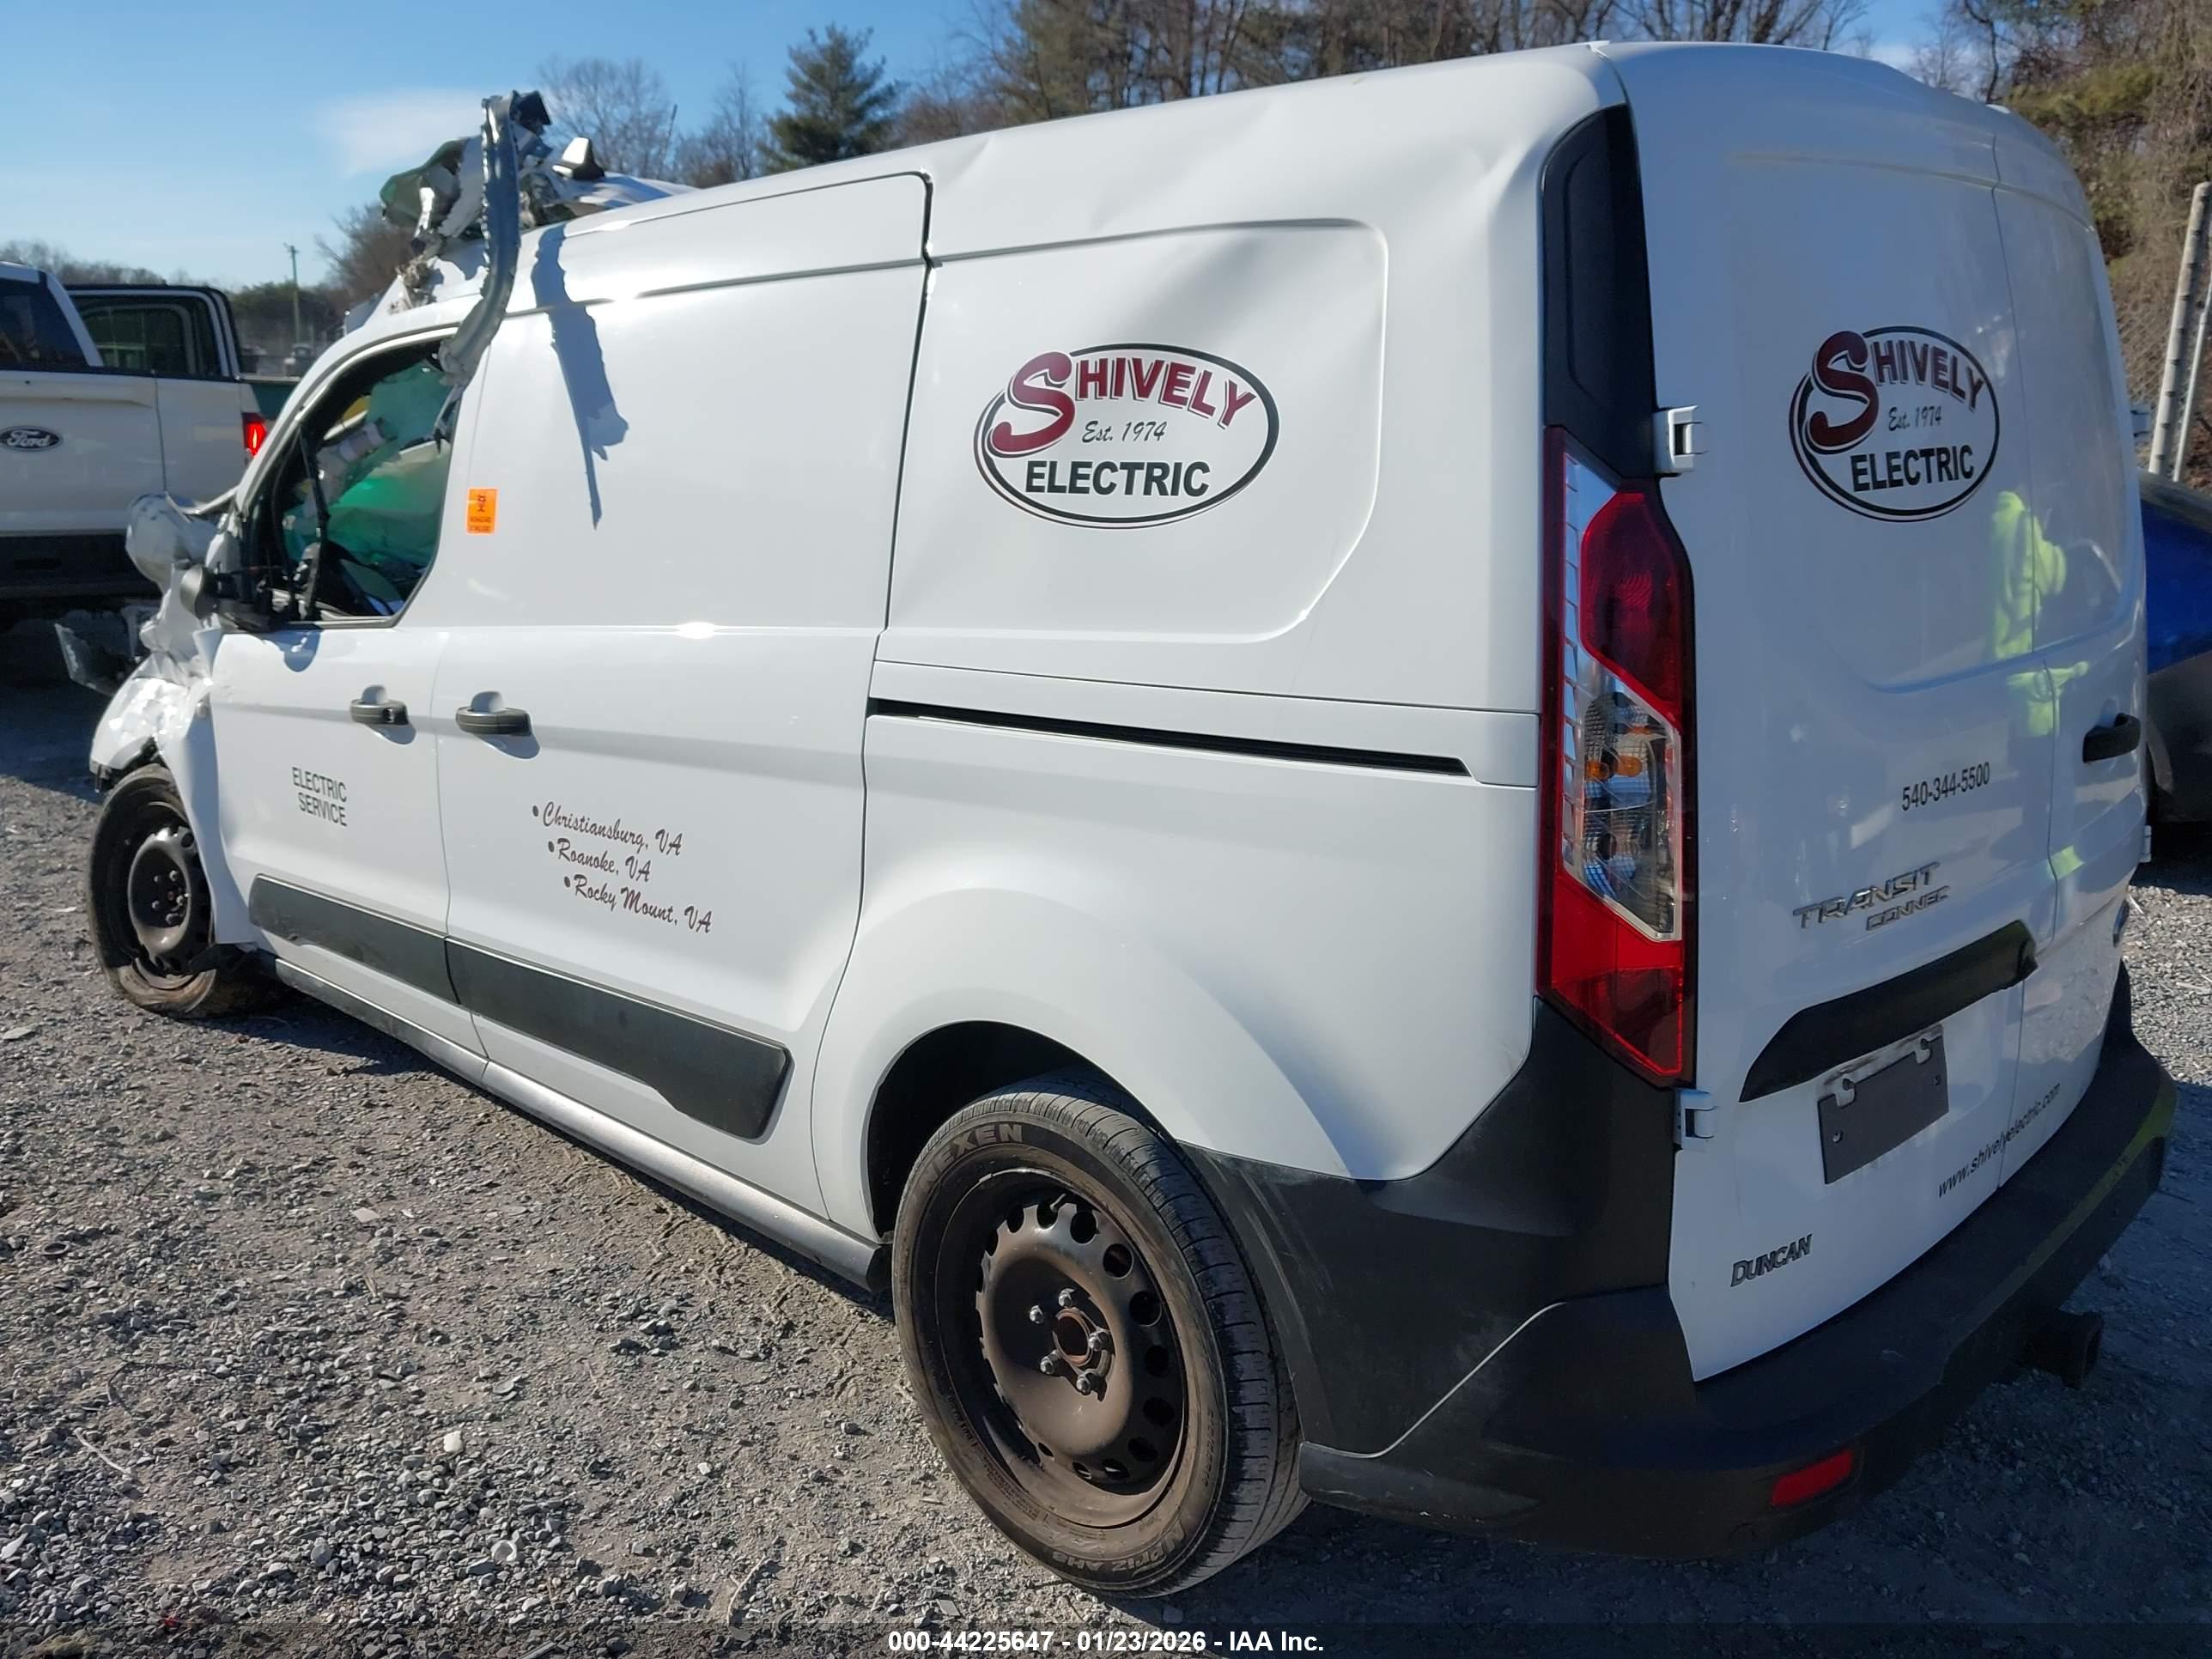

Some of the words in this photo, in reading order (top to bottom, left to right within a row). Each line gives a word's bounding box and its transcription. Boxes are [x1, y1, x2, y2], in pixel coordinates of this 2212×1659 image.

[988, 351, 1256, 458] SHIVELY
[1803, 330, 1984, 455] SHIVELY
[6, 429, 51, 447] Ford
[1081, 420, 1114, 443] Est.
[1121, 420, 1168, 442] 1974
[1888, 406, 1911, 431] Est.
[1915, 405, 1942, 427] 1974
[1024, 459, 1211, 497] ELECTRIC
[1850, 444, 1975, 492] ELECTRIC
[292, 766, 347, 803] ELECTRIC
[1901, 762, 1991, 811] 540-344-5500
[298, 792, 348, 827] SERVICE
[543, 801, 649, 854] Christiansburg,
[655, 829, 684, 856] VA
[556, 837, 620, 876] Roanoke,
[624, 855, 652, 882] VA
[574, 873, 617, 912] Rocky
[620, 886, 678, 927] Mount,
[684, 905, 713, 934] VA
[1792, 860, 1941, 929] TRANSIT
[919, 1122, 1023, 1192] NEXEN
[1937, 1082, 2062, 1199] www.shivelyelectric.com
